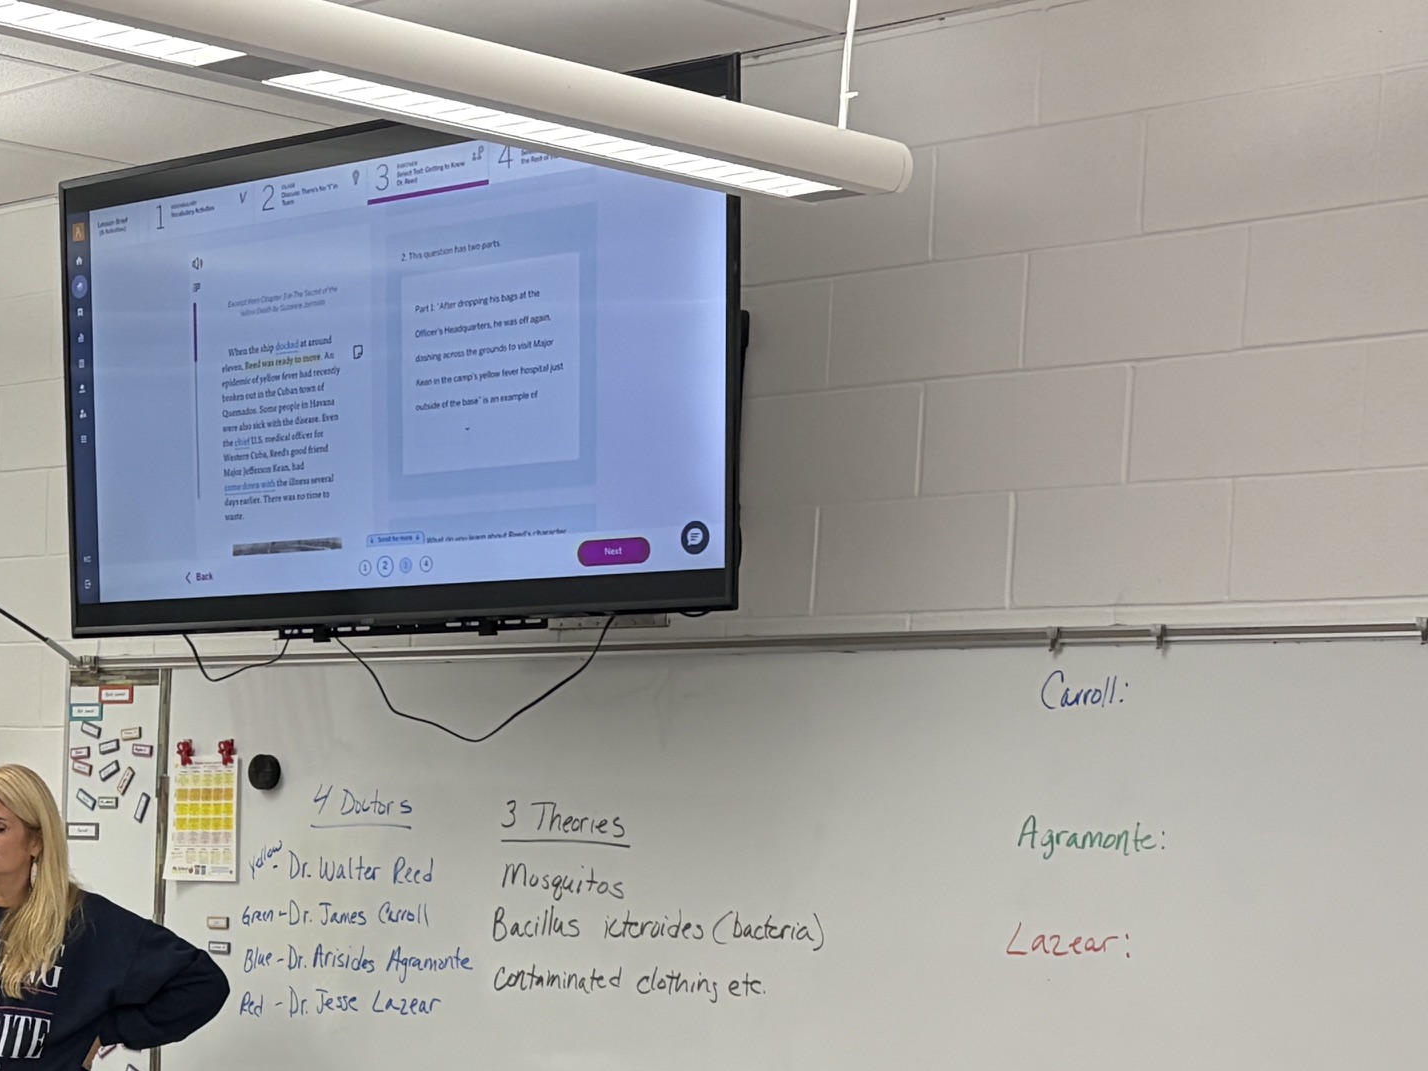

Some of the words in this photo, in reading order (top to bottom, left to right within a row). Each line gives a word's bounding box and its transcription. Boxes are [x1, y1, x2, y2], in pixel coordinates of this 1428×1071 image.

[376, 164, 389, 191] 3
[262, 185, 274, 211] 2
[156, 205, 164, 229] 1
[228, 348, 247, 356] When
[249, 346, 258, 354] the
[261, 343, 274, 353] ship
[443, 350, 464, 360] across
[466, 347, 477, 357] the
[478, 345, 507, 357] grounds
[508, 343, 516, 351] to
[441, 376, 452, 384] the
[479, 370, 500, 381] yellow
[502, 368, 518, 377] fever
[521, 364, 548, 375] hospital
[550, 362, 564, 373] just
[265, 388, 276, 397] the
[450, 398, 460, 407] the
[239, 422, 251, 431] also
[253, 421, 265, 430] sick
[283, 418, 293, 427] the
[291, 446, 306, 457] good
[605, 546, 622, 556] Next
[196, 572, 213, 581] Back
[314, 784, 333, 815] 4
[340, 788, 413, 816] Doctors
[500, 800, 517, 828] 3
[531, 802, 626, 838] Theories
[1018, 814, 1166, 860] Agramonte:
[320, 856, 381, 882] Walter
[393, 856, 433, 884] Reed
[501, 862, 624, 900] Mosquitos
[319, 902, 367, 925] James
[492, 905, 580, 942] Bacillus
[1005, 922, 1130, 959] Lazear:
[244, 946, 273, 973] Blue
[386, 946, 473, 984] Agramonte
[636, 966, 718, 1003] clothing
[728, 972, 766, 997] etc.
[239, 991, 263, 1017] Red
[316, 988, 359, 1014] Jesse
[372, 990, 442, 1015] Lazear
